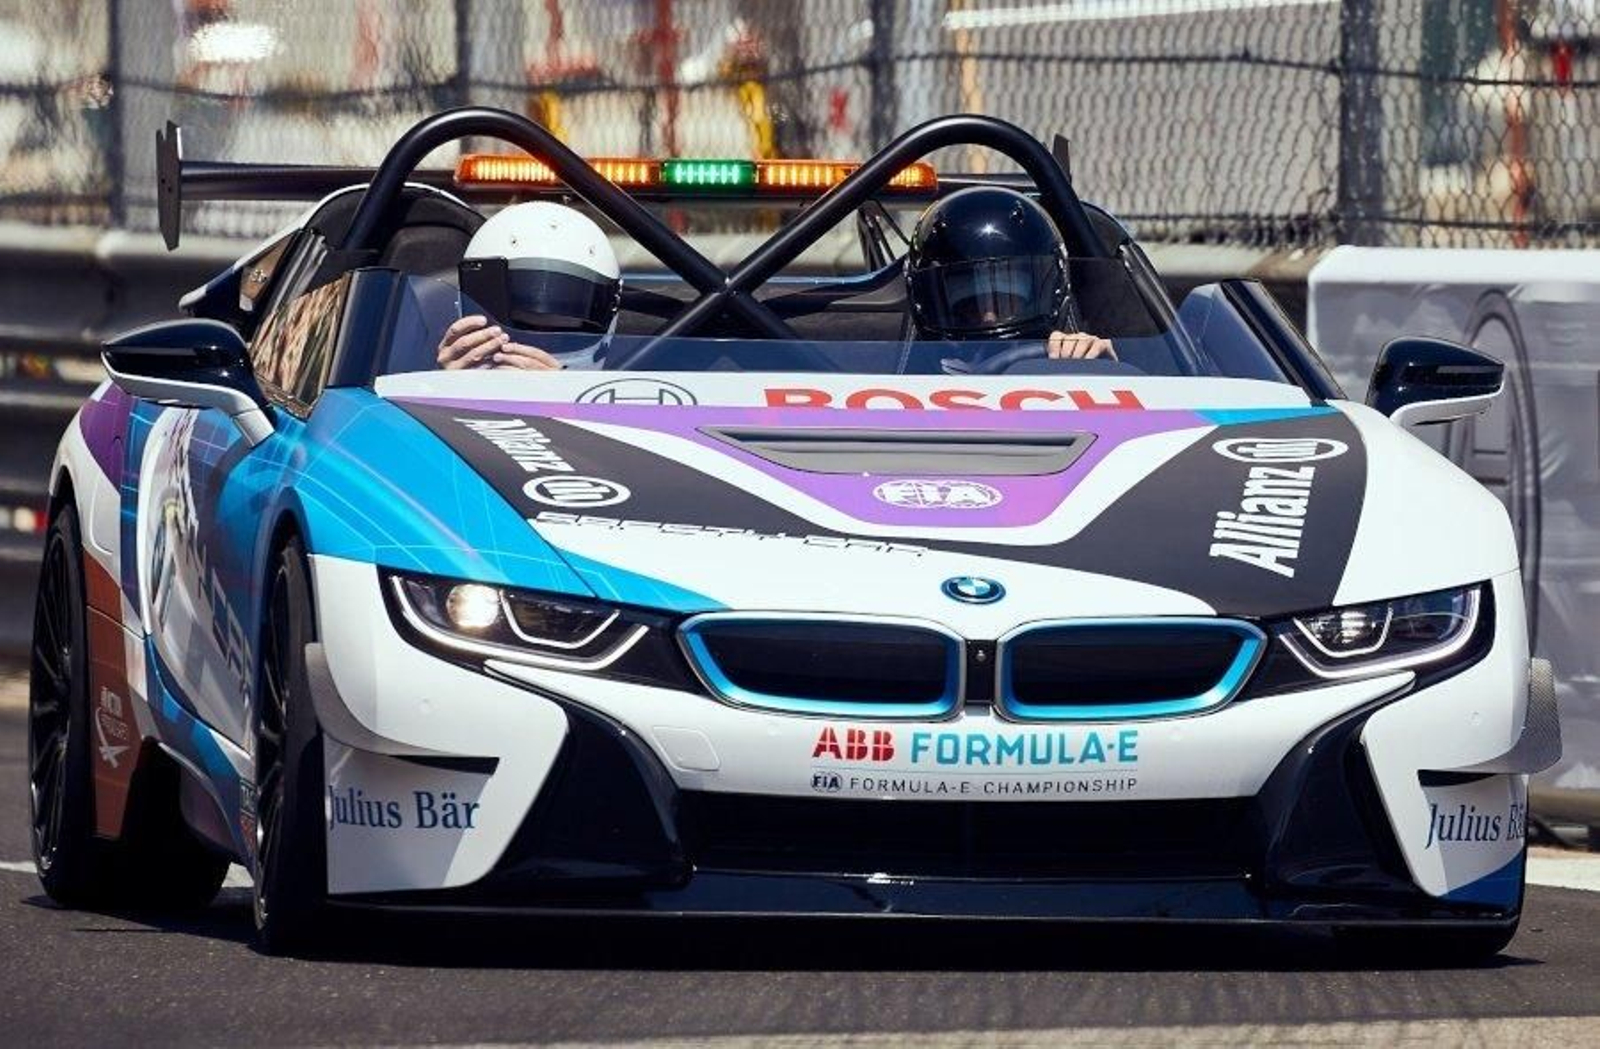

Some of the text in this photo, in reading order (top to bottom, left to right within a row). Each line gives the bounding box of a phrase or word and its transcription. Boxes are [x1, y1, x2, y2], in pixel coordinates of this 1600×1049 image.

[453, 418, 575, 472] Allianz
[878, 481, 997, 507] FIA
[1209, 466, 1315, 578] Allianz
[811, 727, 895, 762] ABB
[812, 774, 1138, 794] FIA FORMULA-E CHAMPIONSHIP
[329, 785, 480, 830] Julius Bär
[1425, 803, 1502, 850] Julius
